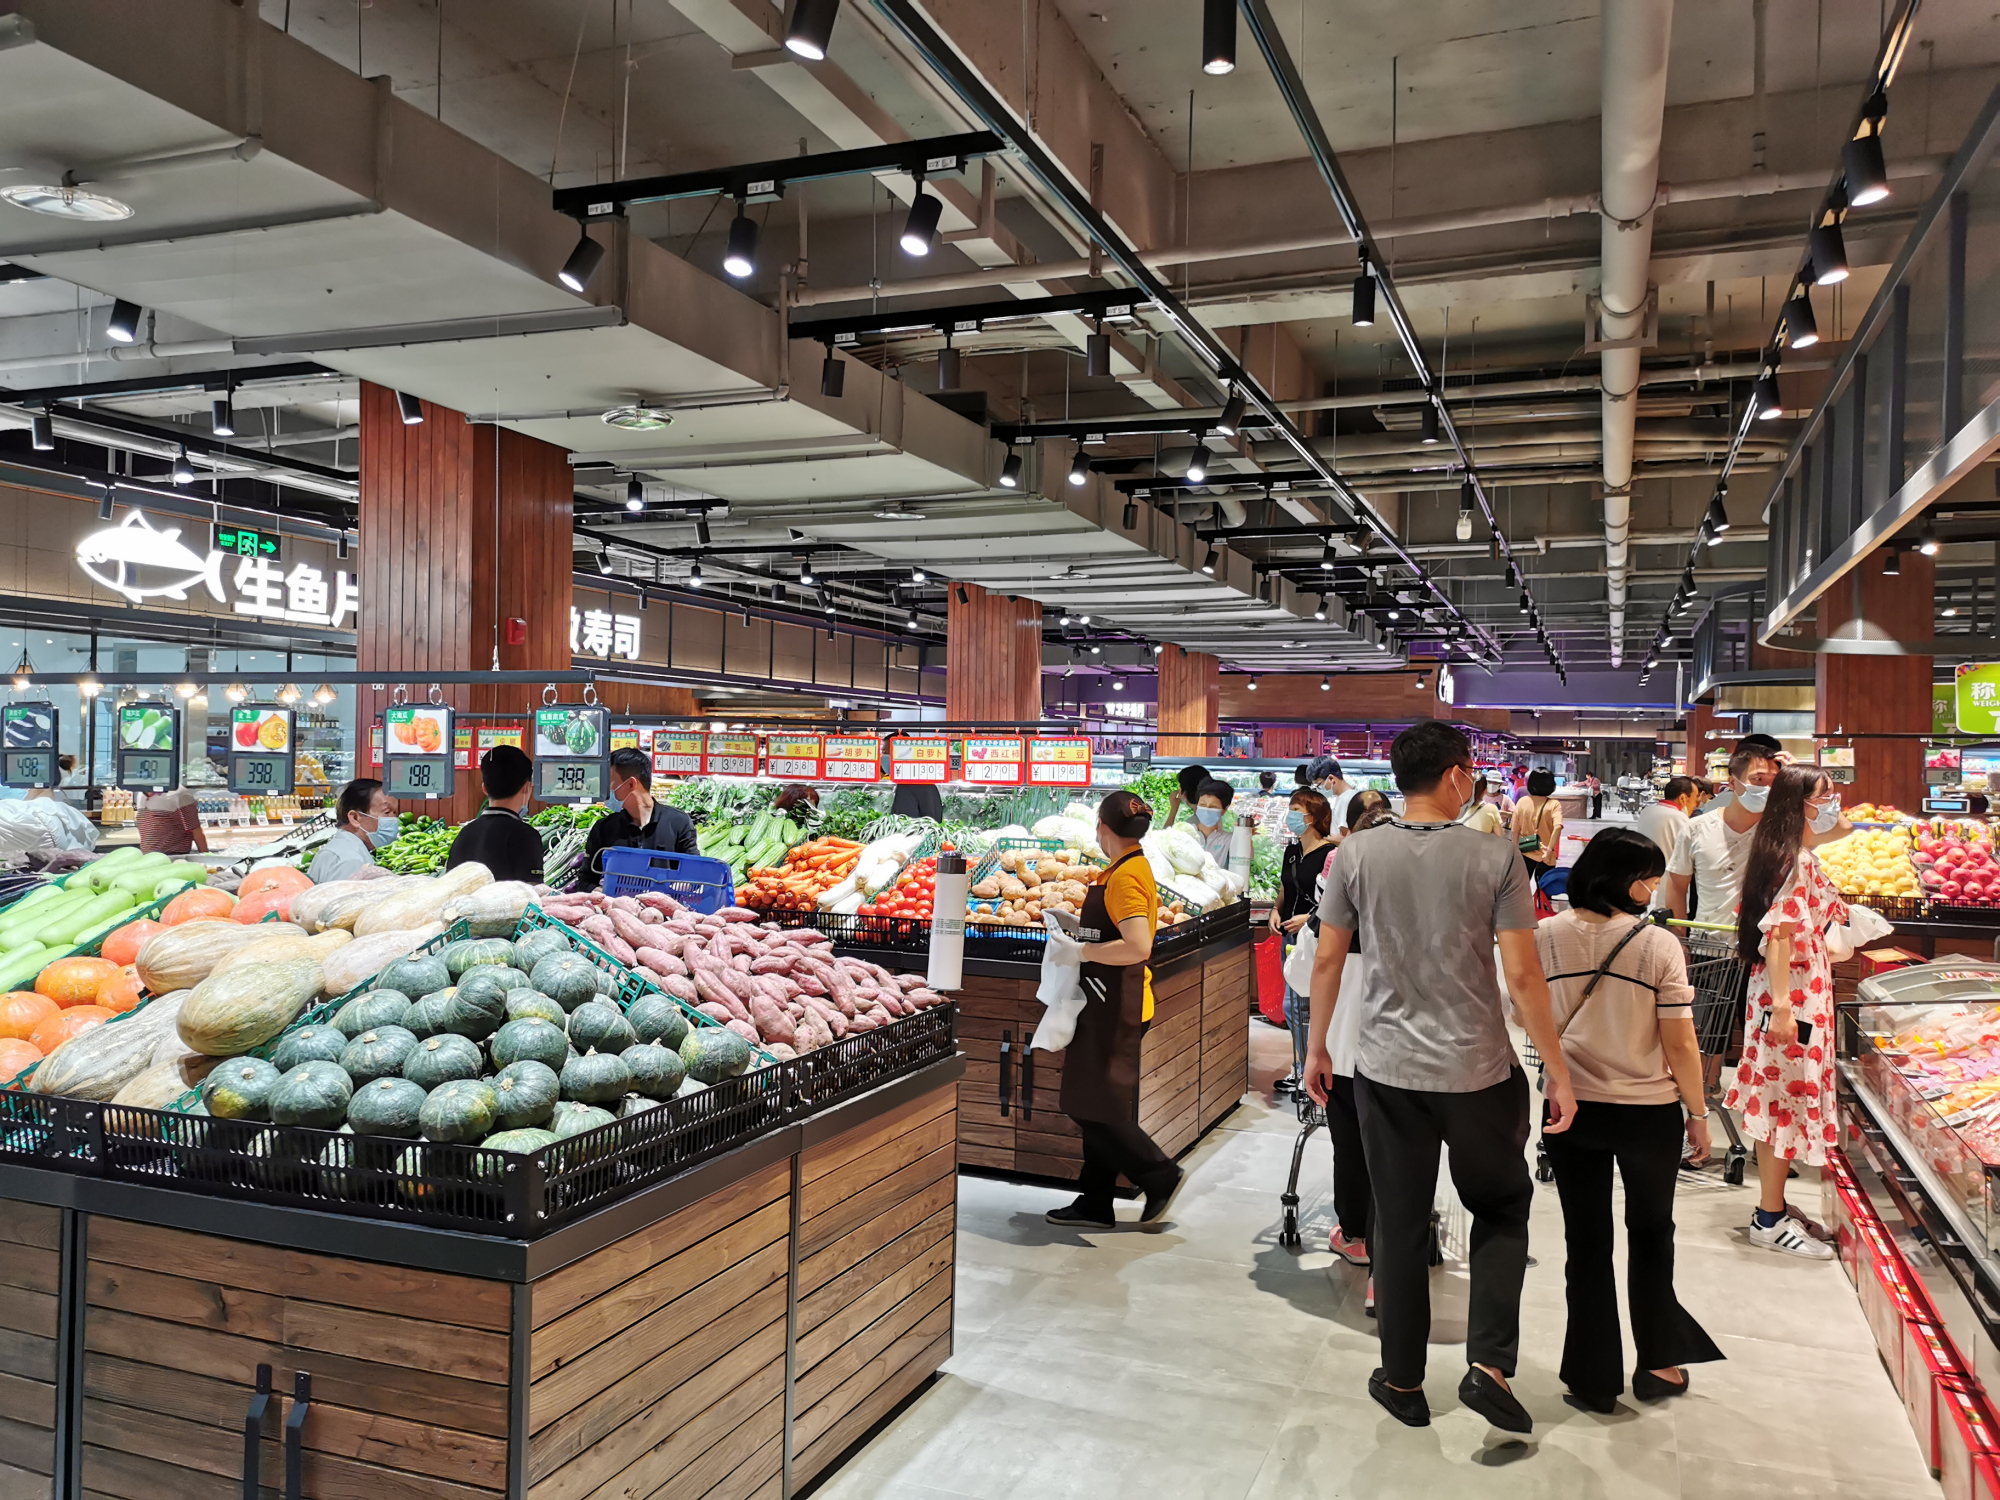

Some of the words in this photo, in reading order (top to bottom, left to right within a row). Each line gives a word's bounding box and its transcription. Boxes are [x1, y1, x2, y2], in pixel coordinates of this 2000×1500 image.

[794, 746, 814, 755] 苦瓜
[844, 748, 872, 758] 胡萝卜
[916, 748, 943, 758] 白萝卜
[990, 748, 1020, 759] 西红柿
[1057, 749, 1085, 759] 土豆
